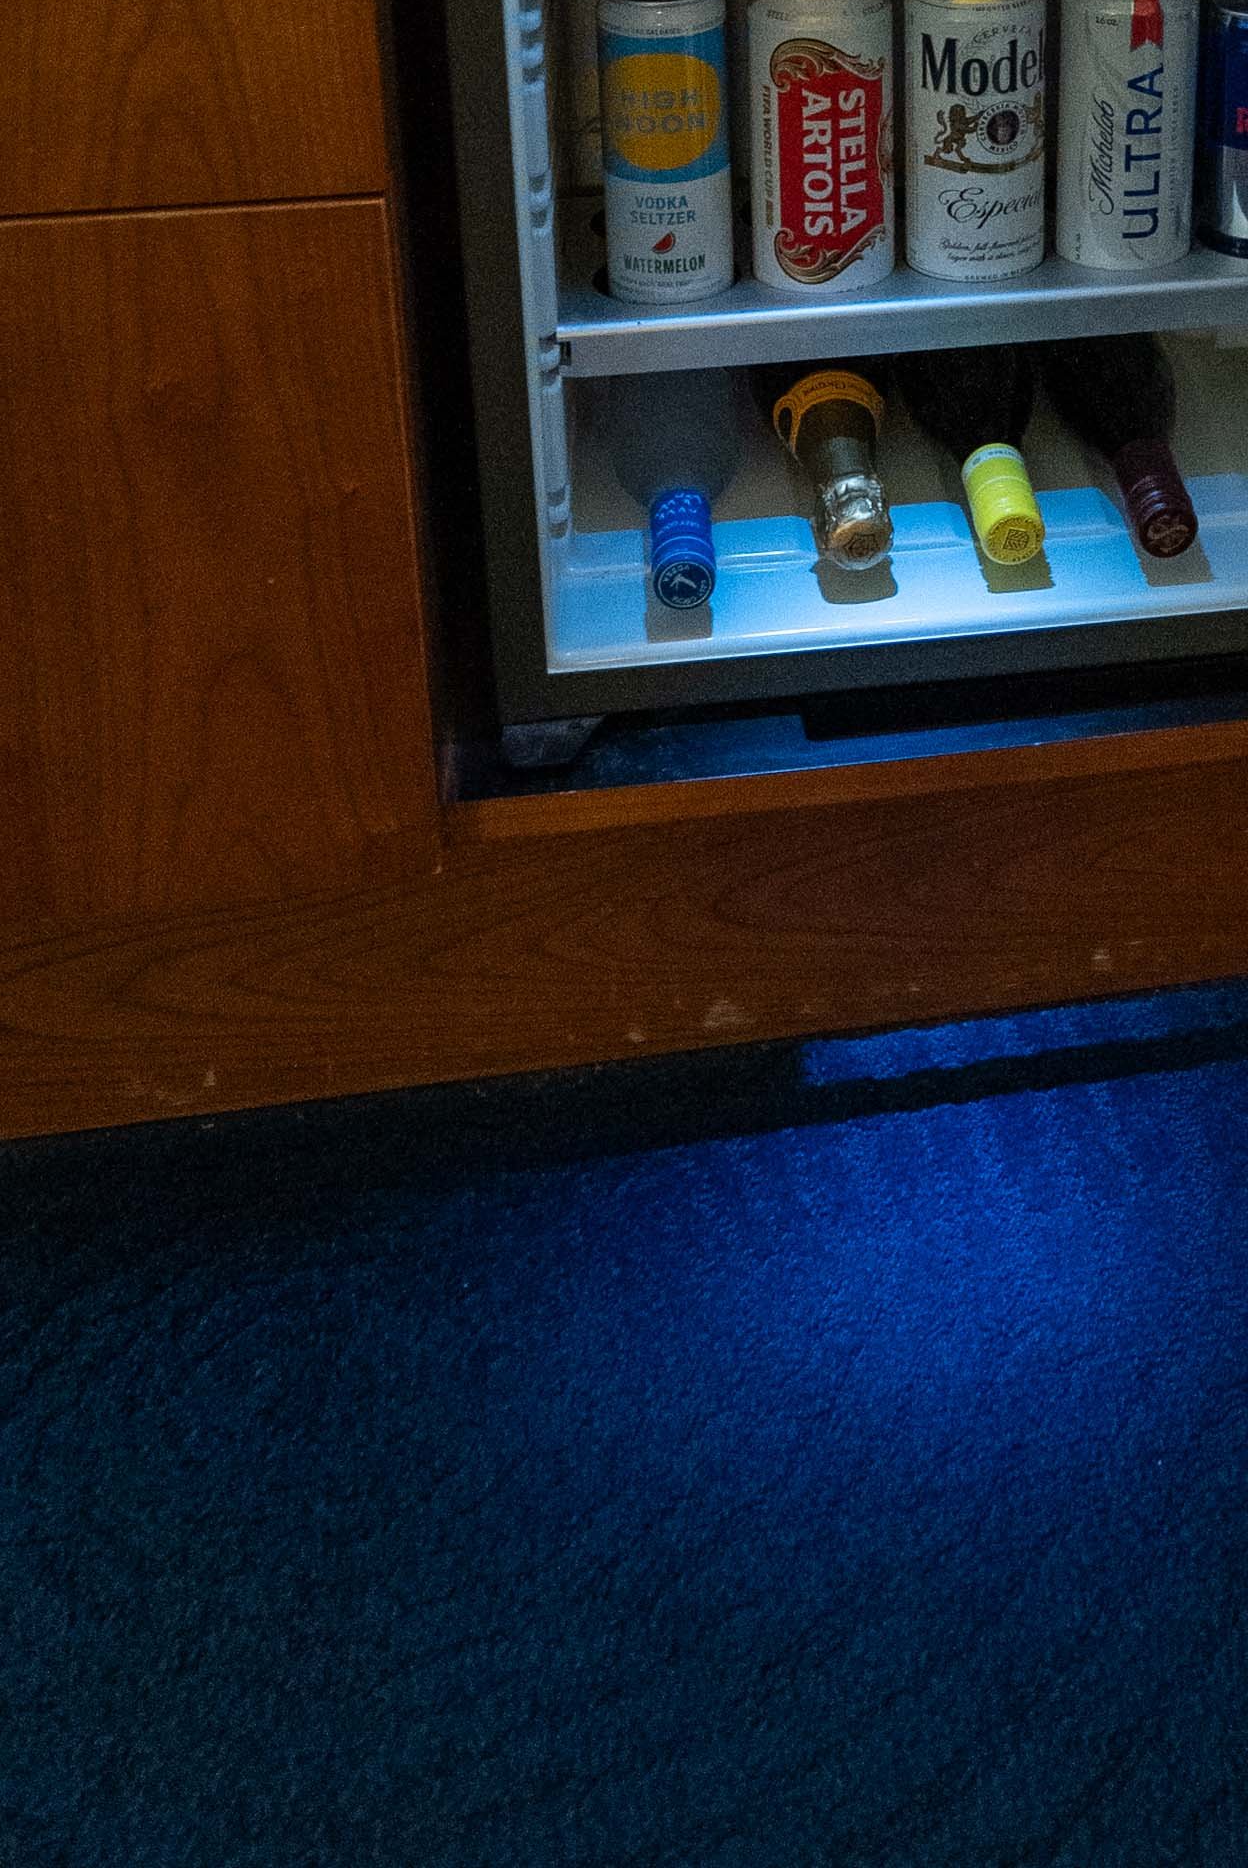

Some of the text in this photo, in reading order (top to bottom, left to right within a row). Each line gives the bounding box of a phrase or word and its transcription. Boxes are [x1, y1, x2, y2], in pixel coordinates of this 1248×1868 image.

[921, 28, 1043, 96] Model
[801, 89, 834, 237] ARTOIS
[838, 88, 868, 234] STELLA
[1089, 99, 1115, 216] Michelob
[1122, 63, 1164, 239] ULTRA
[630, 211, 696, 225] SELTZER
[635, 196, 688, 210] VODKA
[623, 253, 706, 274] WATERMELON
